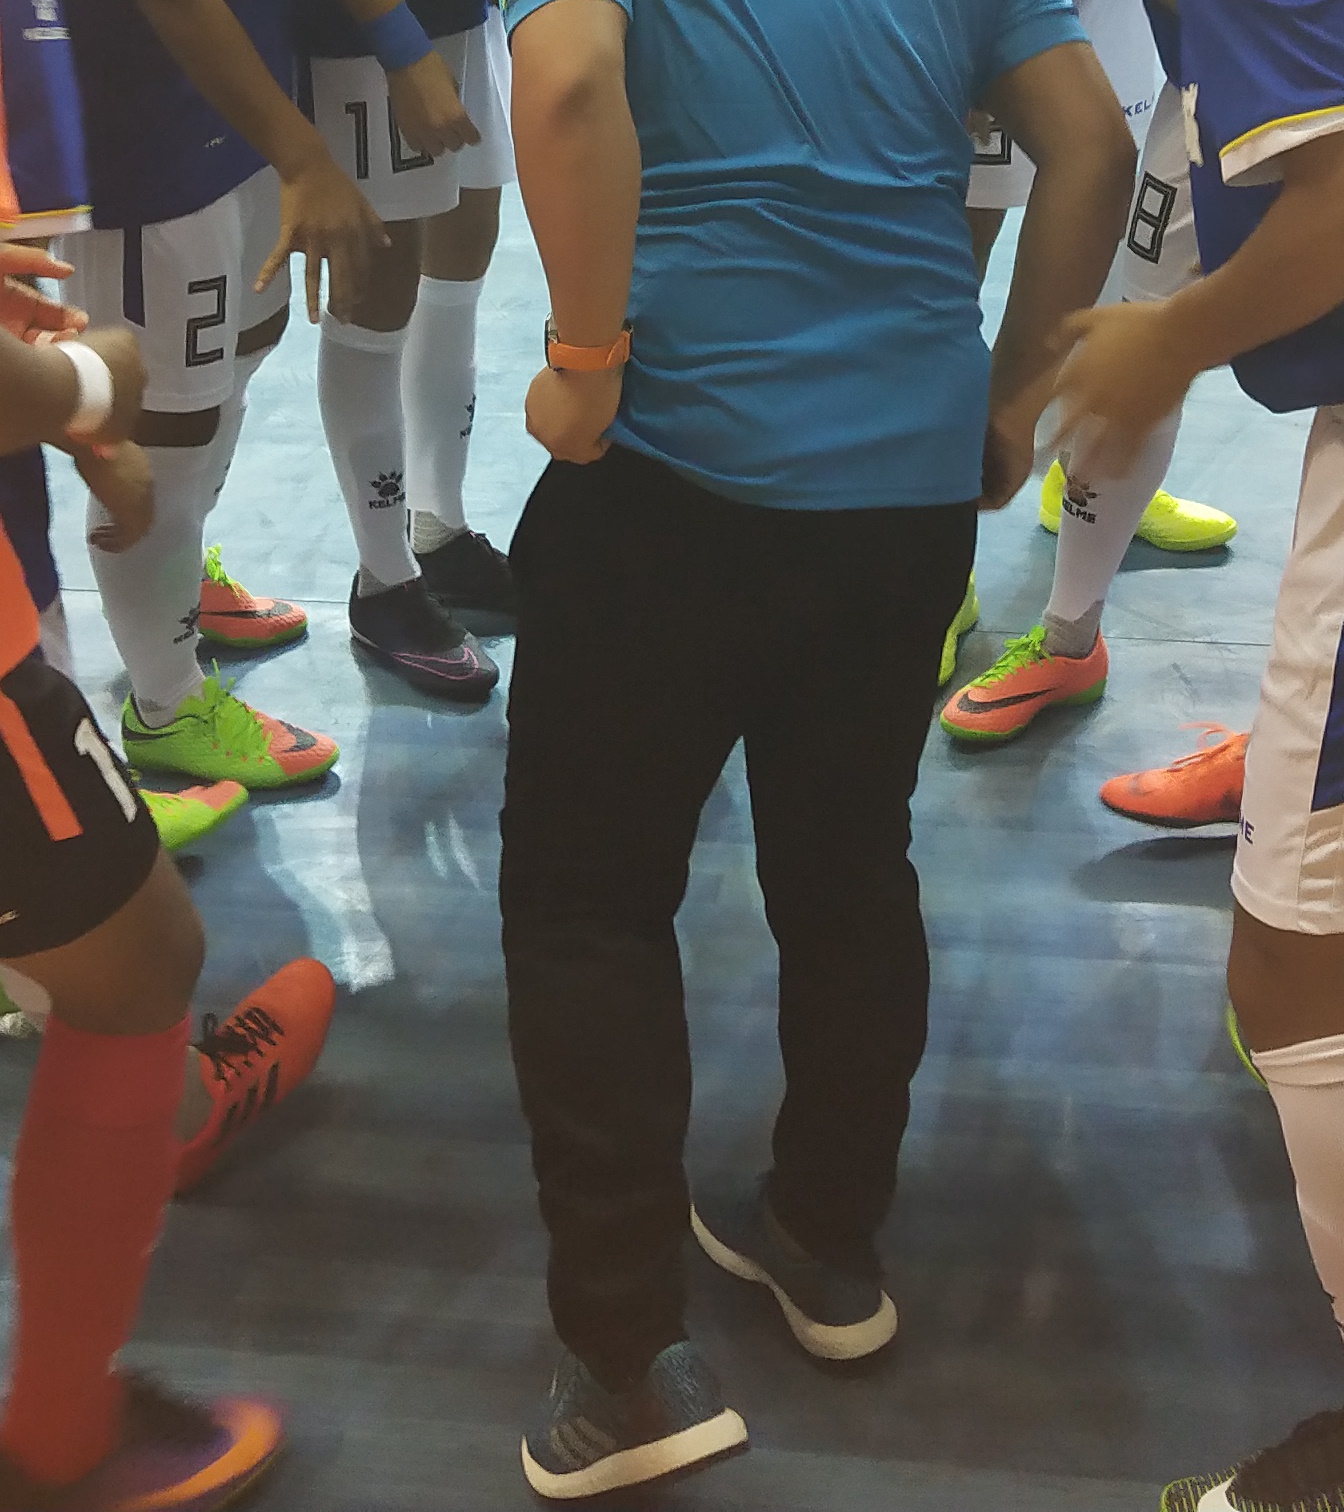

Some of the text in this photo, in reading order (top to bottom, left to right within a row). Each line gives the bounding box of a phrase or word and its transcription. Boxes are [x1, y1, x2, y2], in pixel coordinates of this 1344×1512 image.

[1127, 171, 1178, 264] 8
[185, 275, 227, 367] 2
[368, 492, 406, 510] KELM
